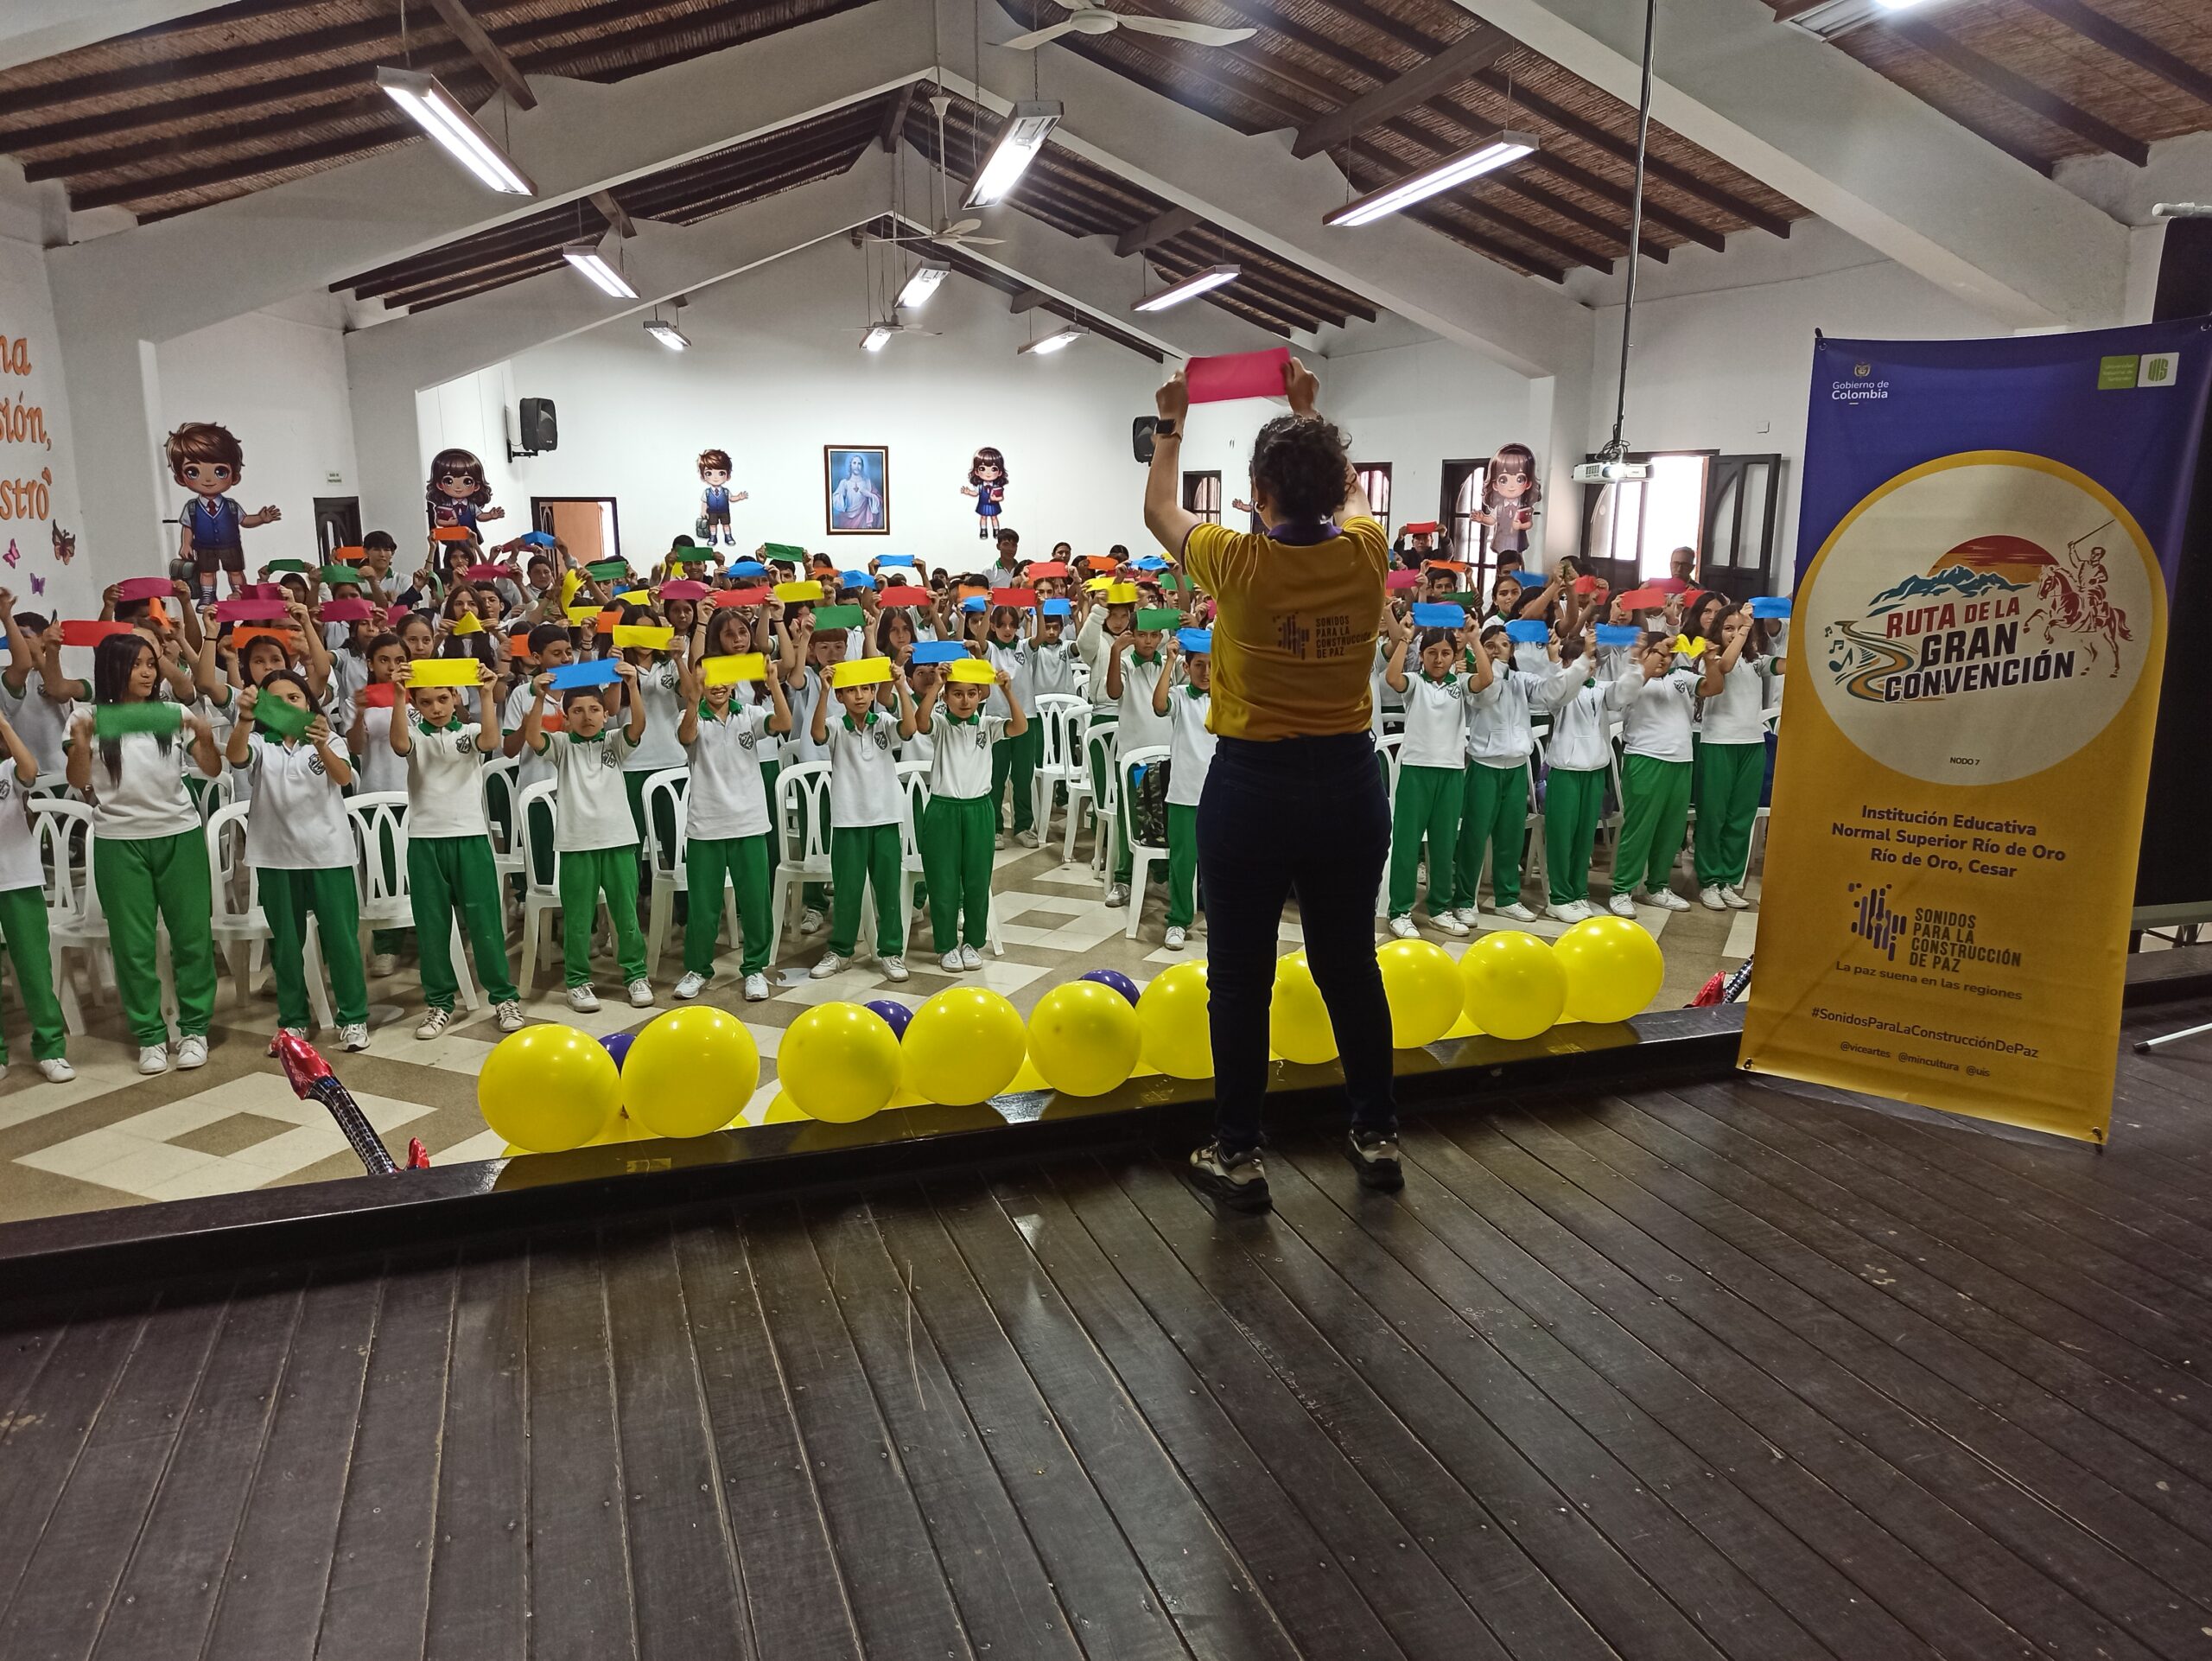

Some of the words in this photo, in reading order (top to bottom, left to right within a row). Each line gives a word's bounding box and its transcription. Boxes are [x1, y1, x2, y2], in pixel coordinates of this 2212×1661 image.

[1832, 381, 1875, 390] Gobierno
[1832, 389, 1888, 400] Colombia
[1315, 615, 1349, 627] SONIDOS
[1316, 627, 1337, 638] PARA
[1340, 626, 1350, 636] LA
[1886, 603, 1956, 639] RUTA
[1964, 601, 1990, 624] DE
[1994, 596, 2020, 619] LA
[1317, 648, 1326, 659] DE
[1330, 646, 1344, 657] PAZ
[1920, 620, 2018, 667] GRAN
[1885, 649, 2075, 703] CONVENCIÓN
[1949, 756, 1974, 766] NODO
[1862, 805, 1948, 826] Institución
[1953, 814, 2037, 836] Educativa
[1832, 823, 1891, 842] Normal
[1896, 829, 1967, 849] Superior
[1972, 837, 2000, 854] Río
[2005, 843, 2026, 856] de
[2032, 844, 2066, 862] Oro
[1871, 848, 1897, 862] Río
[1902, 852, 1922, 866] de
[1927, 855, 1963, 873] Oro,
[1968, 859, 2018, 877] Cesar
[1915, 907, 1976, 929] SONIDOS
[1913, 922, 1950, 941] PARA
[1956, 930, 1974, 945] LA
[1909, 951, 1928, 967] DE
[1932, 956, 1961, 973] PAZ
[1910, 937, 2022, 967] CONSTRUCCIÓN
[1835, 961, 1851, 971] La
[1853, 965, 1877, 977] paz
[1879, 970, 1917, 983] suena
[1921, 977, 1937, 986] en
[1941, 978, 1960, 990] las
[1963, 983, 2023, 1000] regiones
[1811, 1007, 2039, 1059] #SonidosParaLaConstrucciónDePaz
[1840, 1041, 1891, 1059] @viceartes
[1898, 1052, 1959, 1072] @mincultura
[1966, 1065, 1991, 1077] @uis
